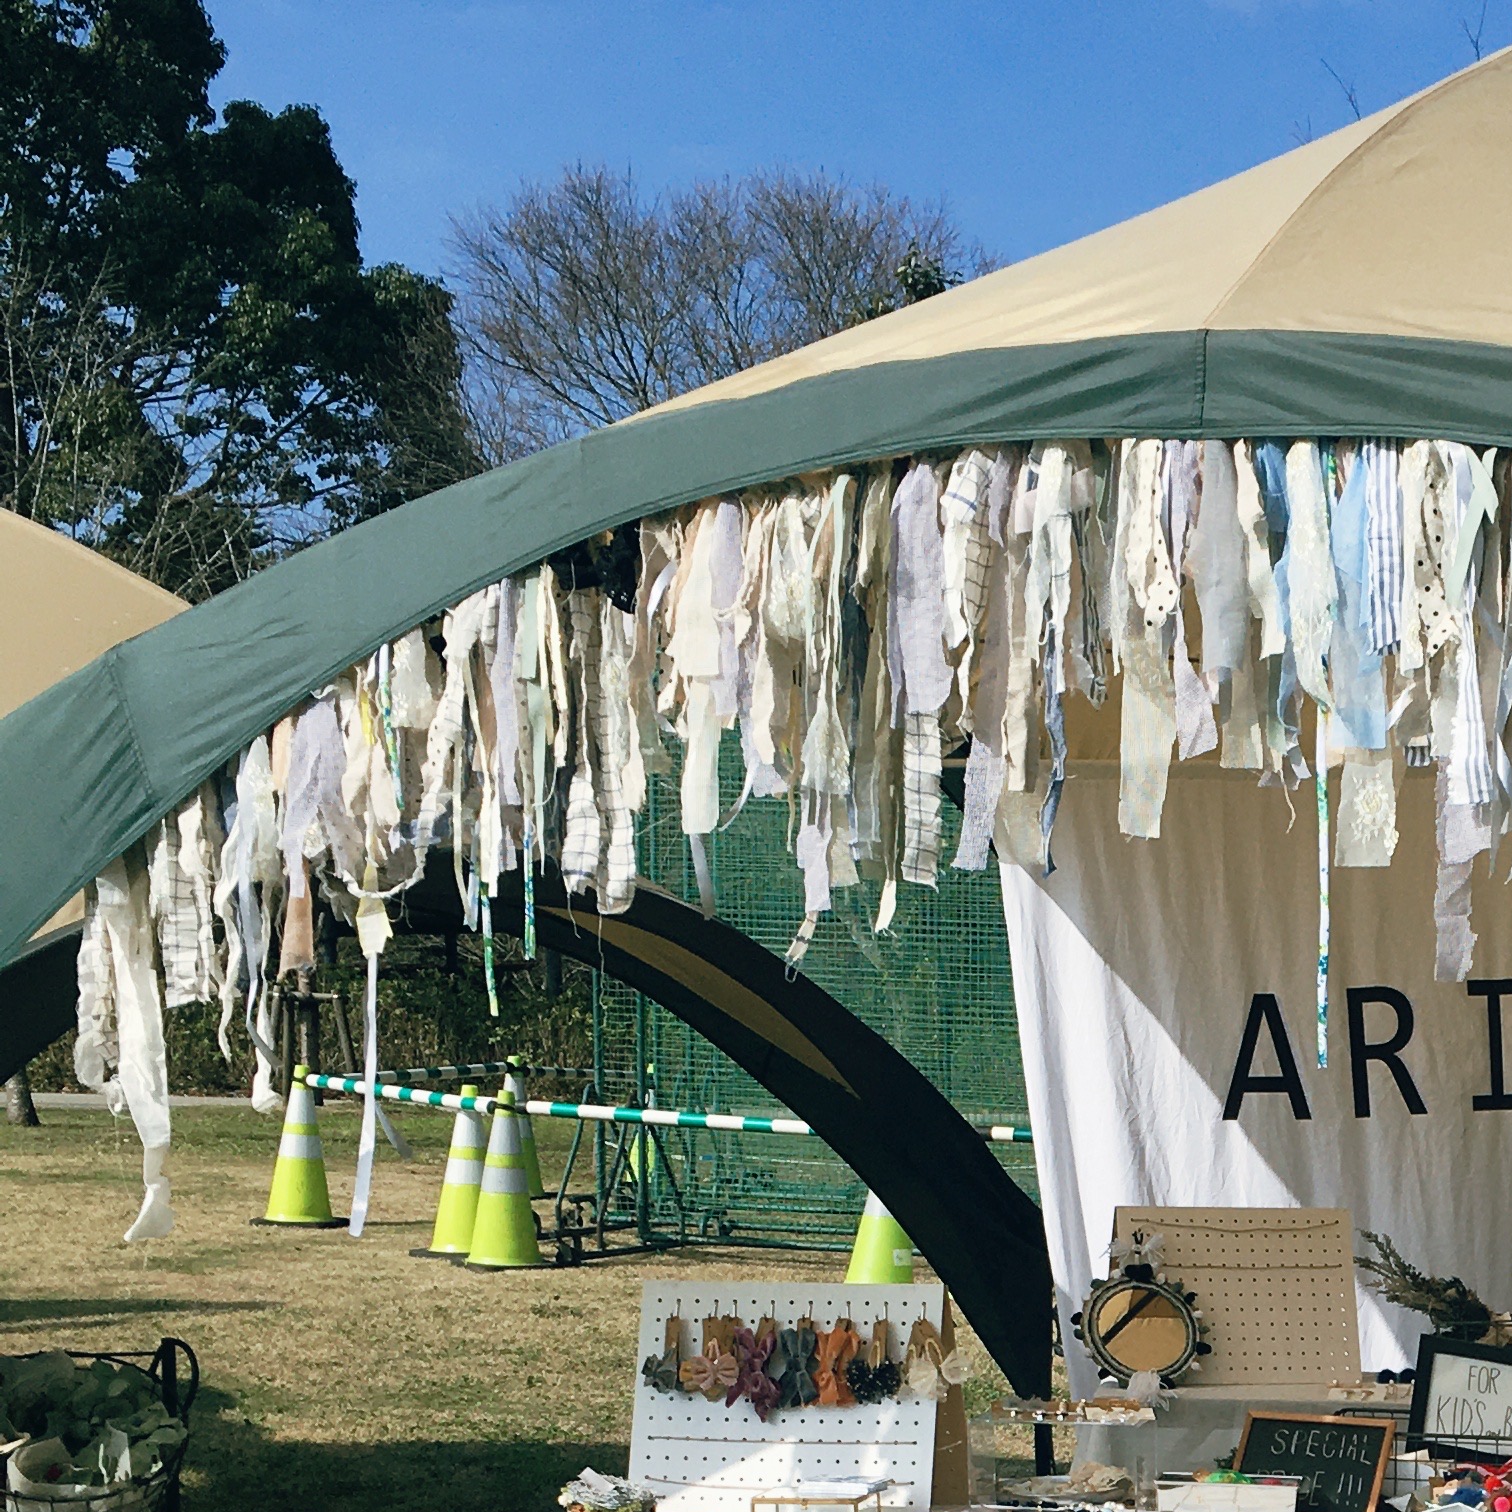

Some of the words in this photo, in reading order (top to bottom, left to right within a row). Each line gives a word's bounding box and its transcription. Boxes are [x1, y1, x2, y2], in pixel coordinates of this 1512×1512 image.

[1467, 1365, 1501, 1395] FOR
[1270, 1429, 1371, 1465] SPECIAL
[1335, 1473, 1363, 1508] !!!
